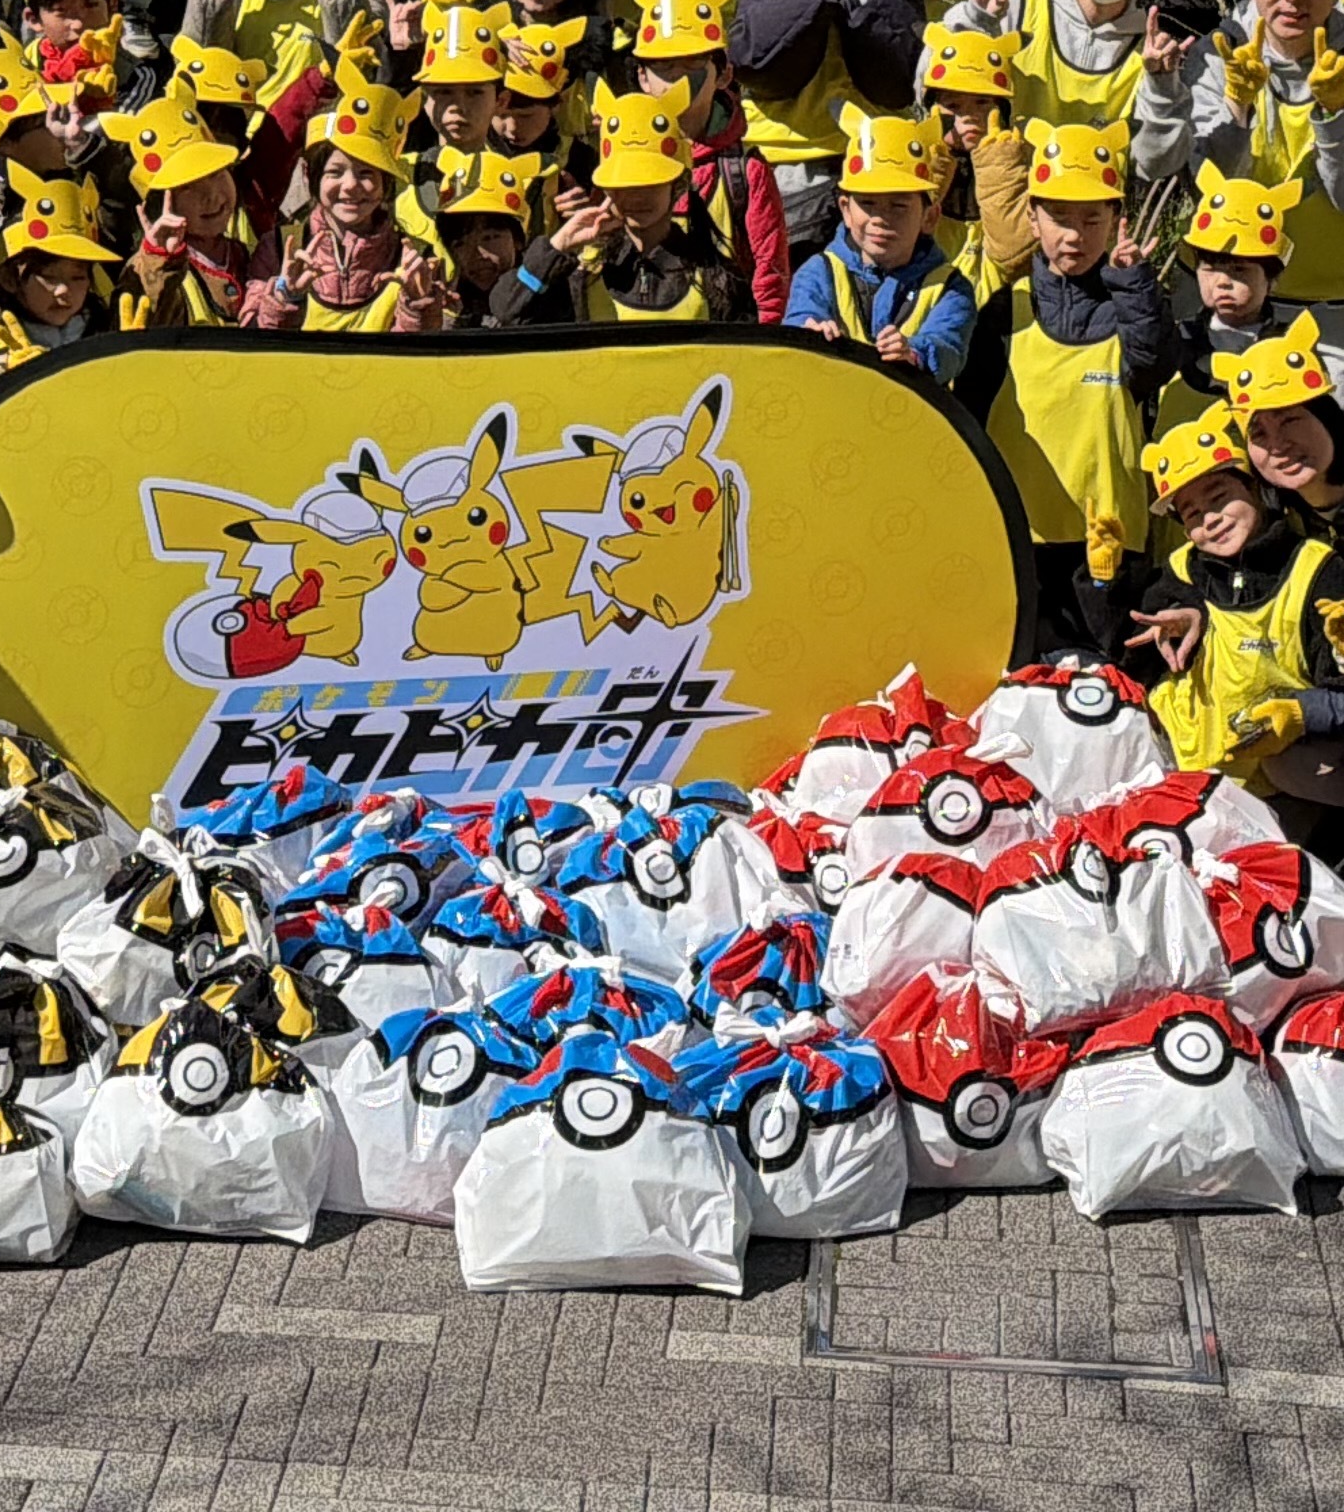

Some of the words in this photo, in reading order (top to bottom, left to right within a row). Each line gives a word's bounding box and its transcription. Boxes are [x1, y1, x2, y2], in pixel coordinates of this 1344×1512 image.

[626, 665, 660, 681] だん
[253, 680, 449, 714] ポケモン
[180, 635, 761, 809] ピカピカ団
